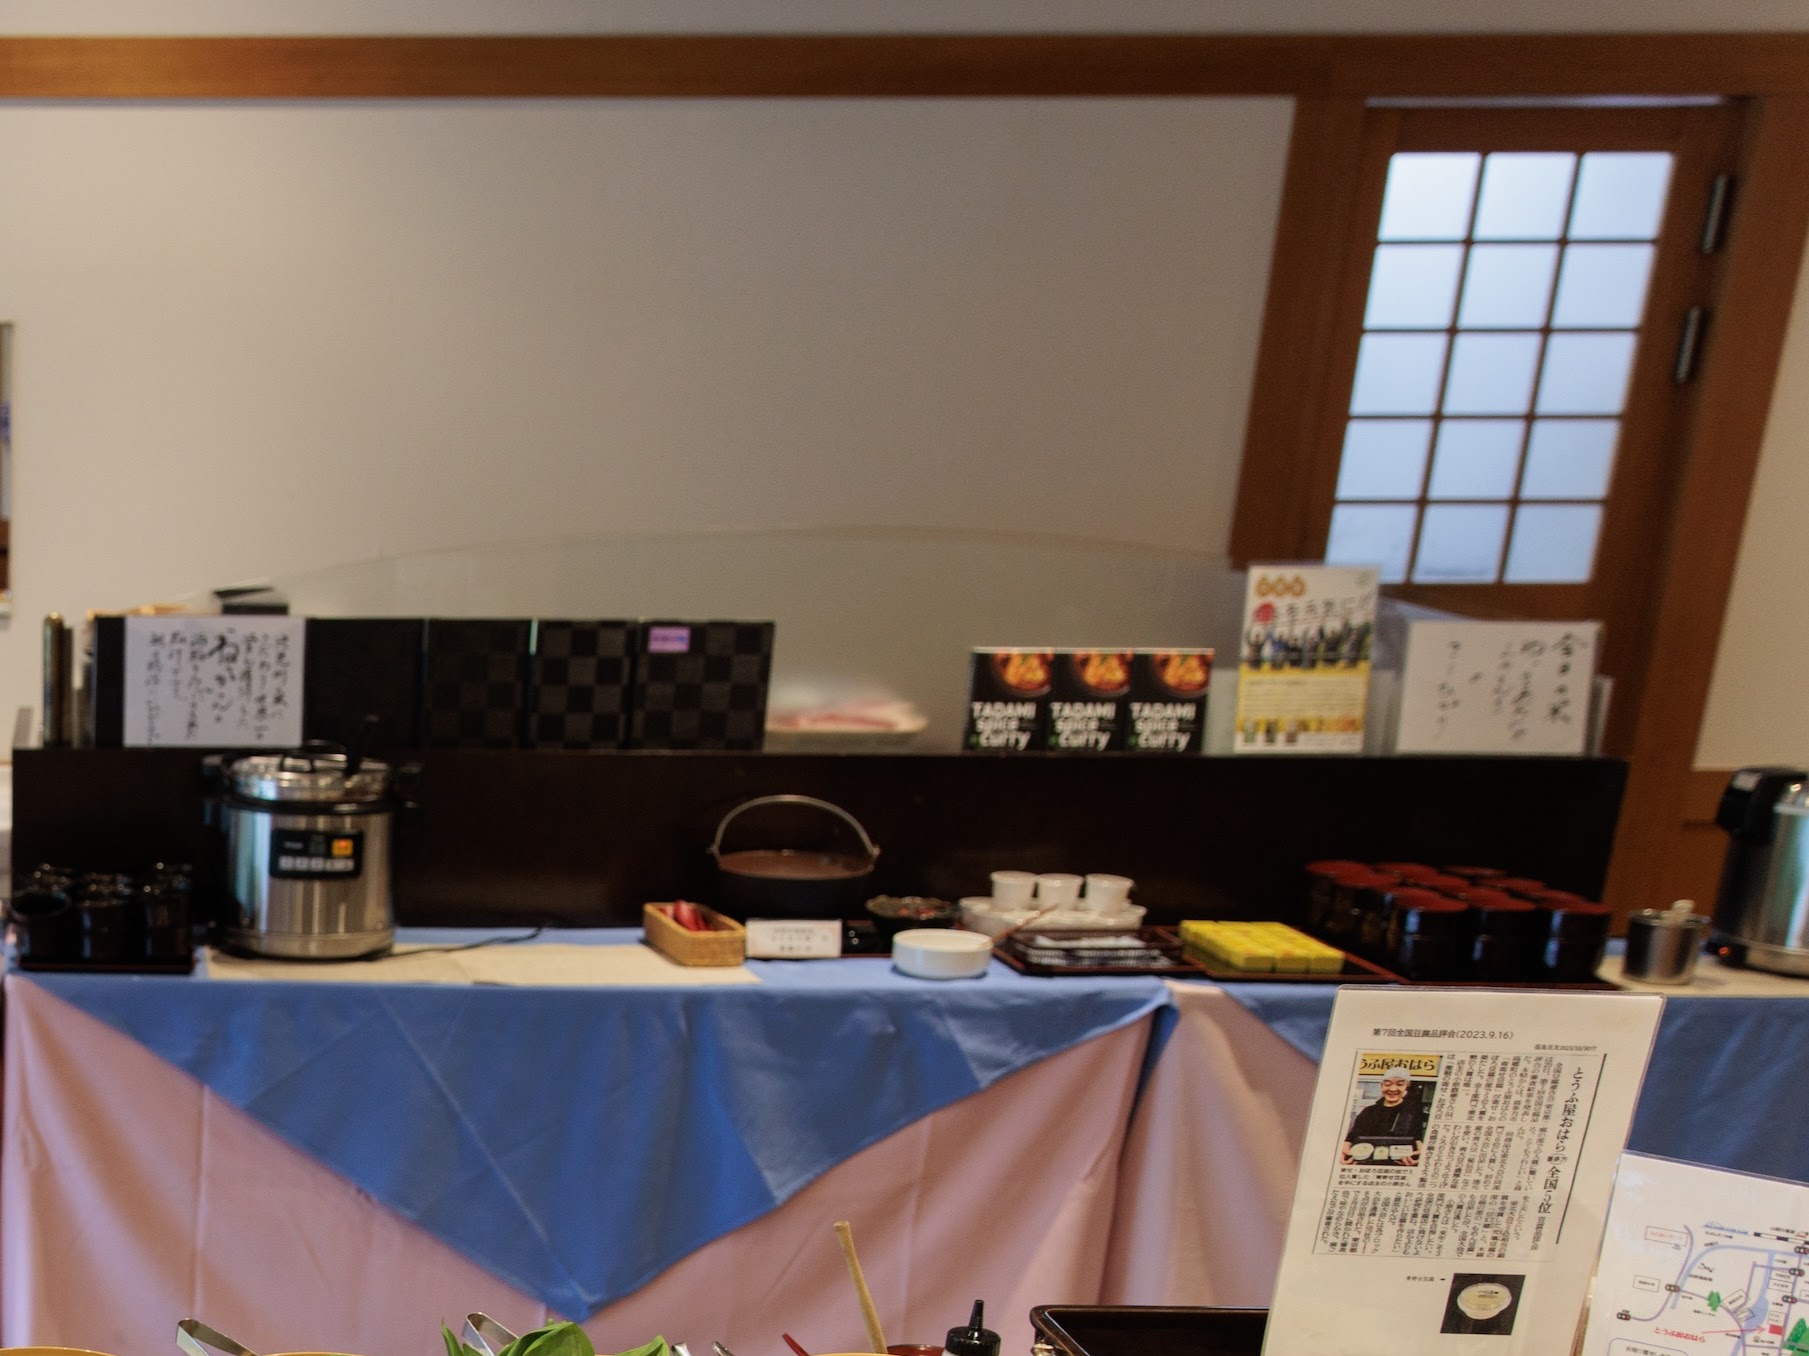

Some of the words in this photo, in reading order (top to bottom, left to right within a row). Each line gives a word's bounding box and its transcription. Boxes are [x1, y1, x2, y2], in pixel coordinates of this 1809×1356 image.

[1552, 1067, 1588, 1152] とうふ屋おはら
[1536, 1165, 1563, 1214] 全国5位
